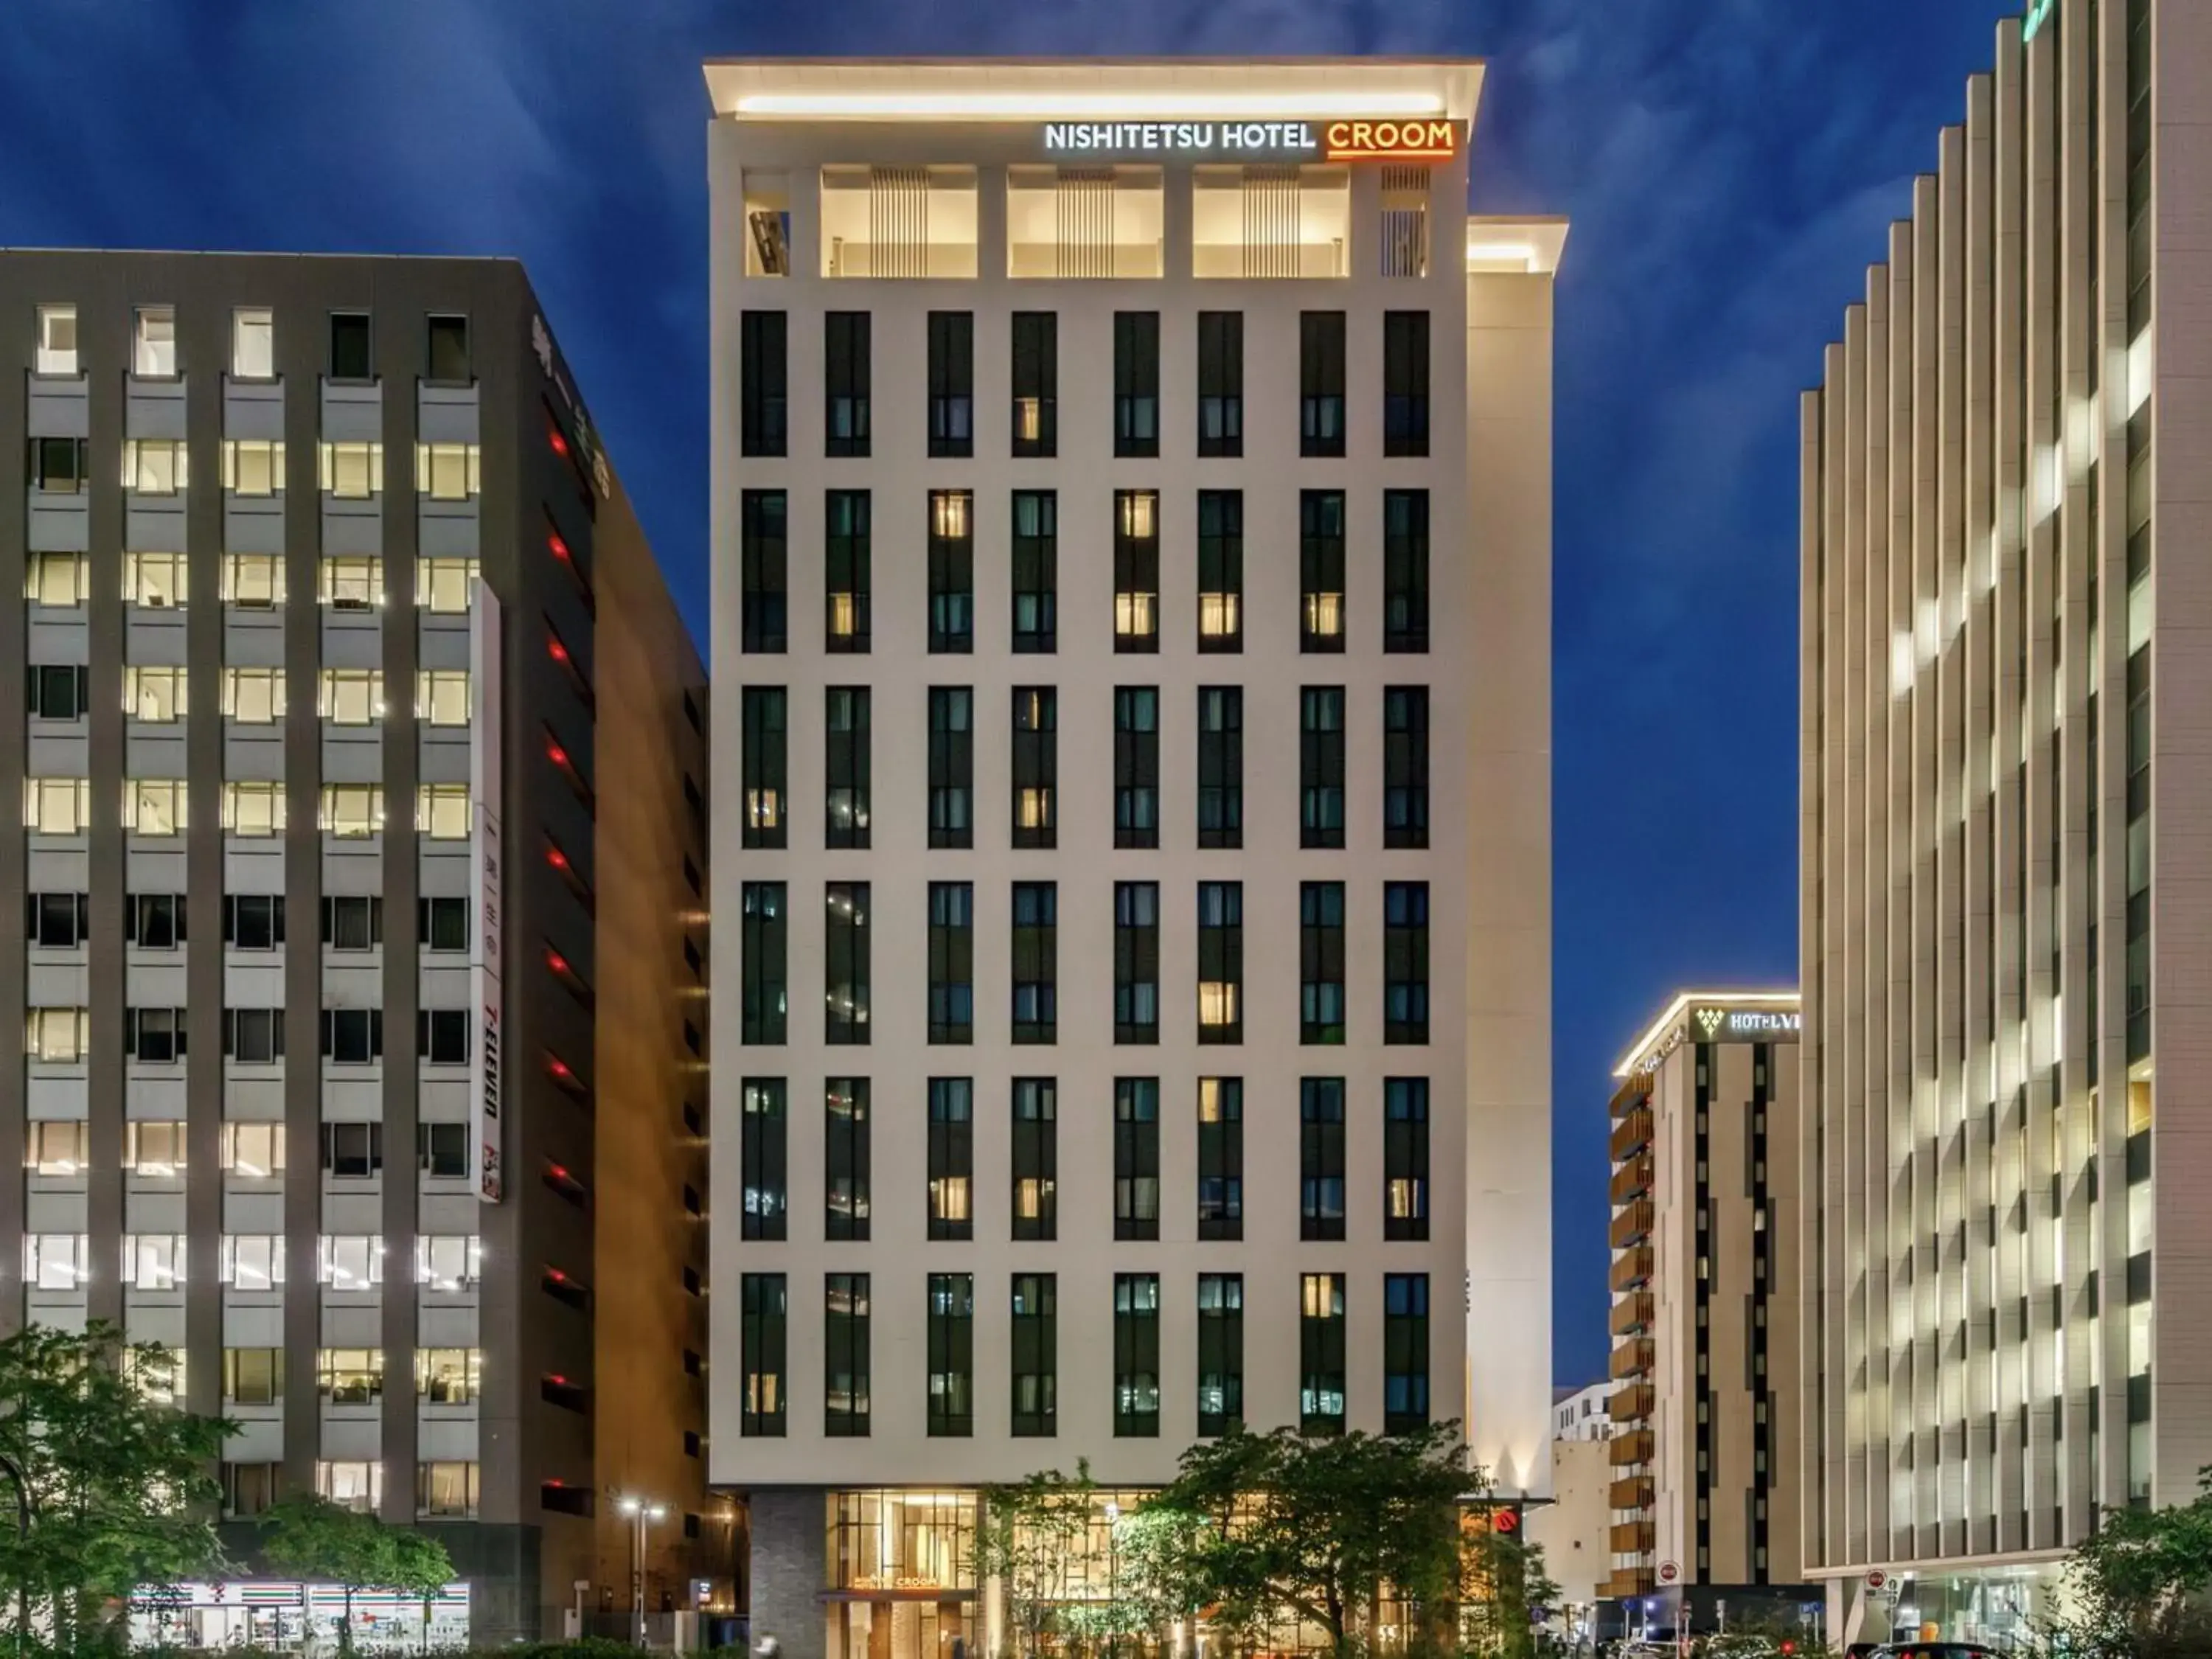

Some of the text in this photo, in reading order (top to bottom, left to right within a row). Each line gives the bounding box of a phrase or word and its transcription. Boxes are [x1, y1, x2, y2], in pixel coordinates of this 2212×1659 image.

[1046, 122, 1453, 149] NISHITETSU HOTEL CROOM
